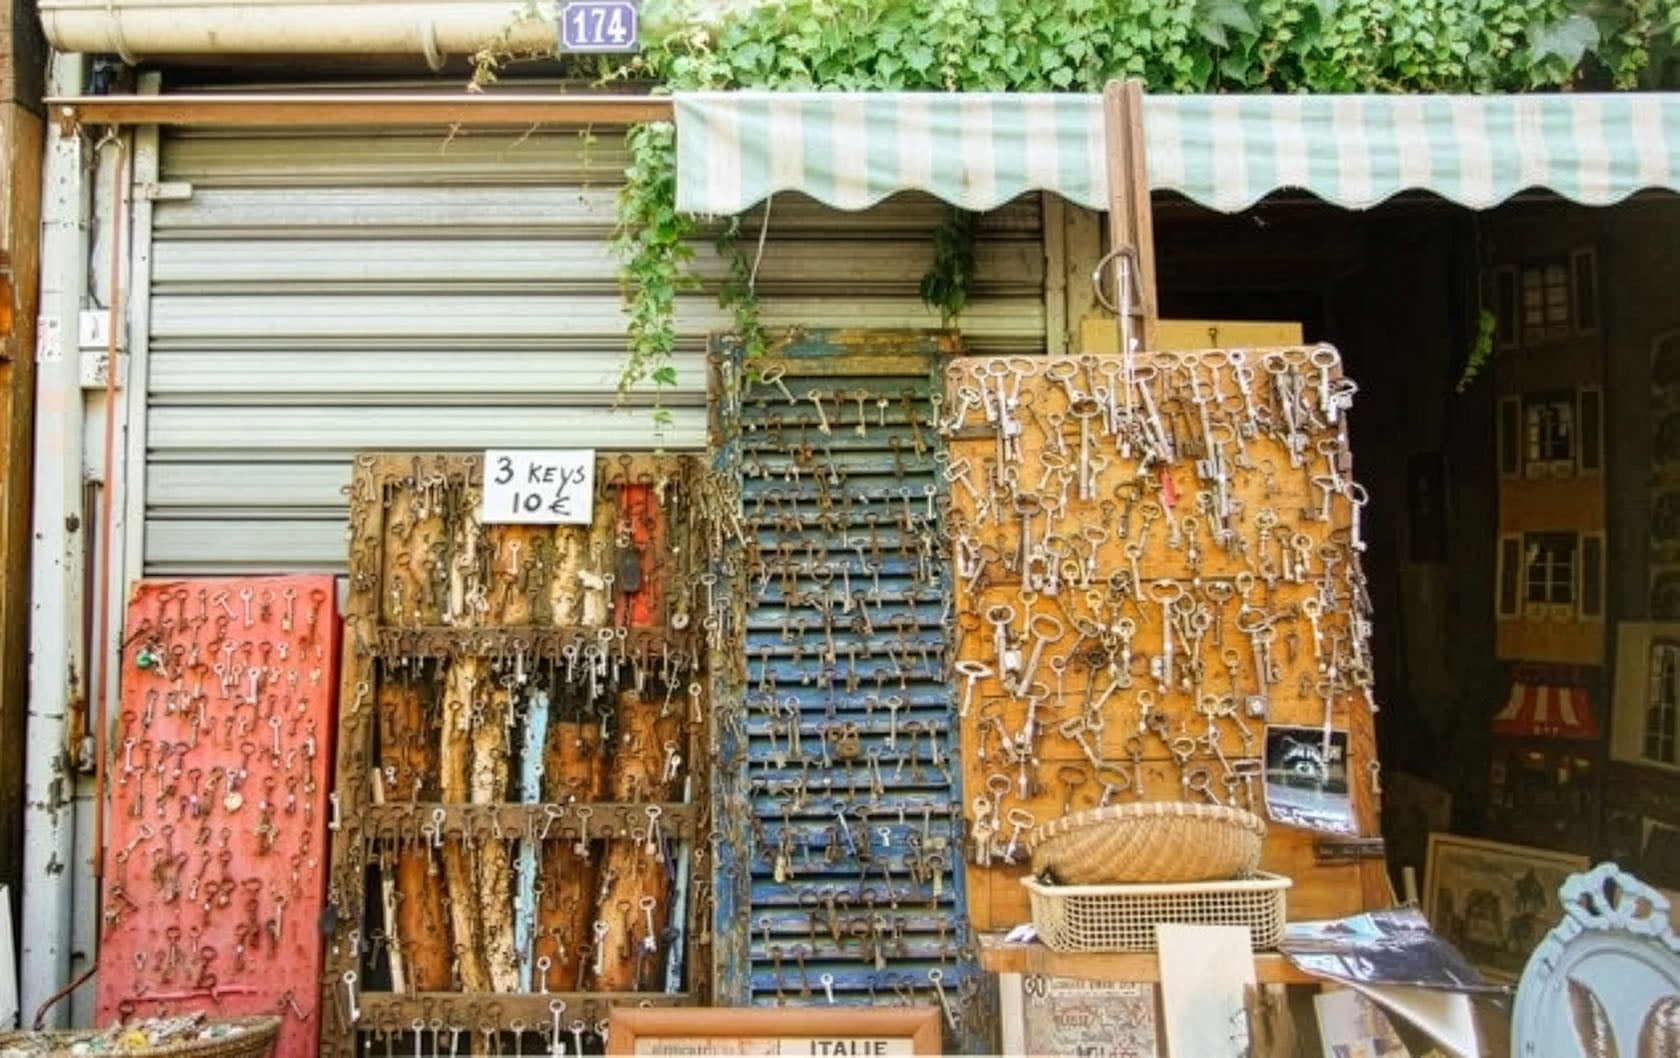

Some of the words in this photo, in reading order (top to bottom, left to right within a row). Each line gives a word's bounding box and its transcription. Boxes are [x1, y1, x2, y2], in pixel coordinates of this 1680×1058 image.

[573, 8, 627, 43] 174
[494, 456, 515, 485] 3
[528, 462, 586, 498] KEYS
[810, 1039, 888, 1056] ITALIE
